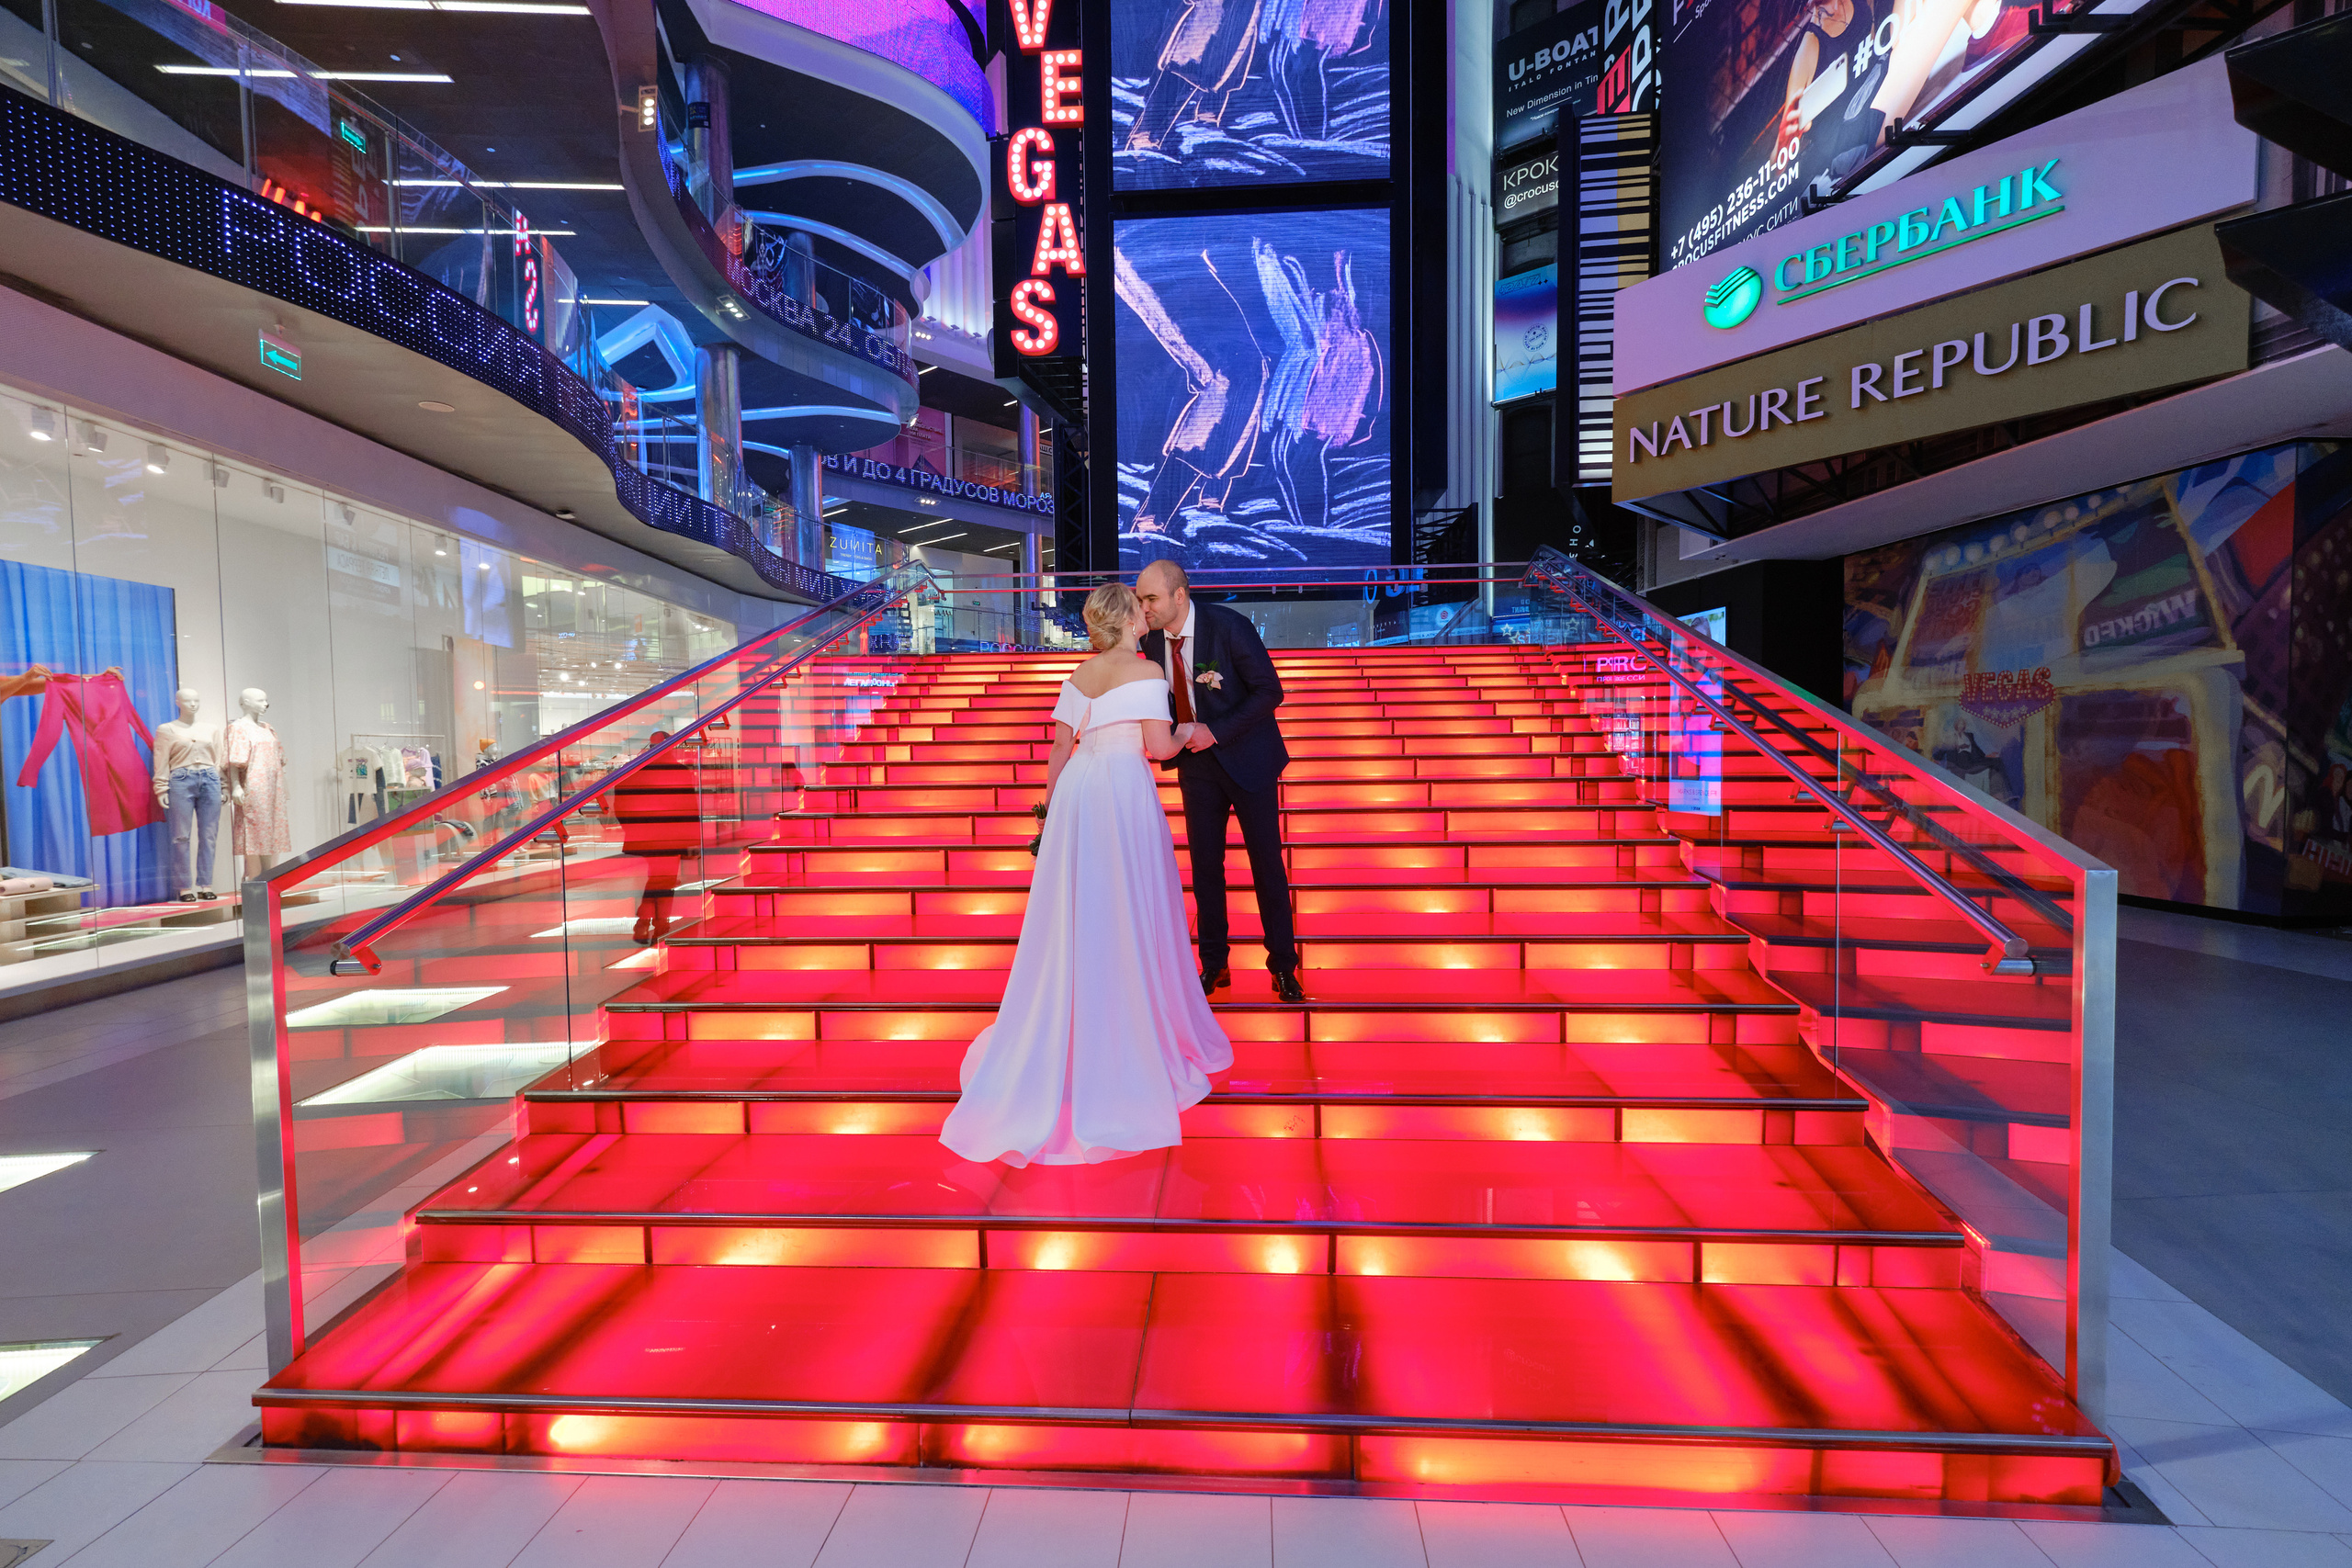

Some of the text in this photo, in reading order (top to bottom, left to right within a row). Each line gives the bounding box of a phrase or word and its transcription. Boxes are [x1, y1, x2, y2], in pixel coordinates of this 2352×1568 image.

[1506, 104, 1525, 118] New
[1527, 85, 1572, 109] Dimension
[1574, 81, 1583, 90] in
[1509, 73, 1542, 93] ITALO
[1008, 0, 1086, 356] VEGAS
[1670, 136, 1800, 260] +7 (495) 236-11-00
[1766, 196, 1799, 232] СИТИ
[1773, 158, 2063, 292] СБЕРБАНК
[1628, 277, 2199, 464] NATURE REPUBLIC
[843, 454, 857, 474] И
[862, 458, 891, 479] ДО
[894, 467, 906, 483] 4
[910, 468, 1000, 503] ГРАДУСОВ
[829, 536, 883, 556] ZUMITA
[1962, 666, 2057, 705] VEGAS
